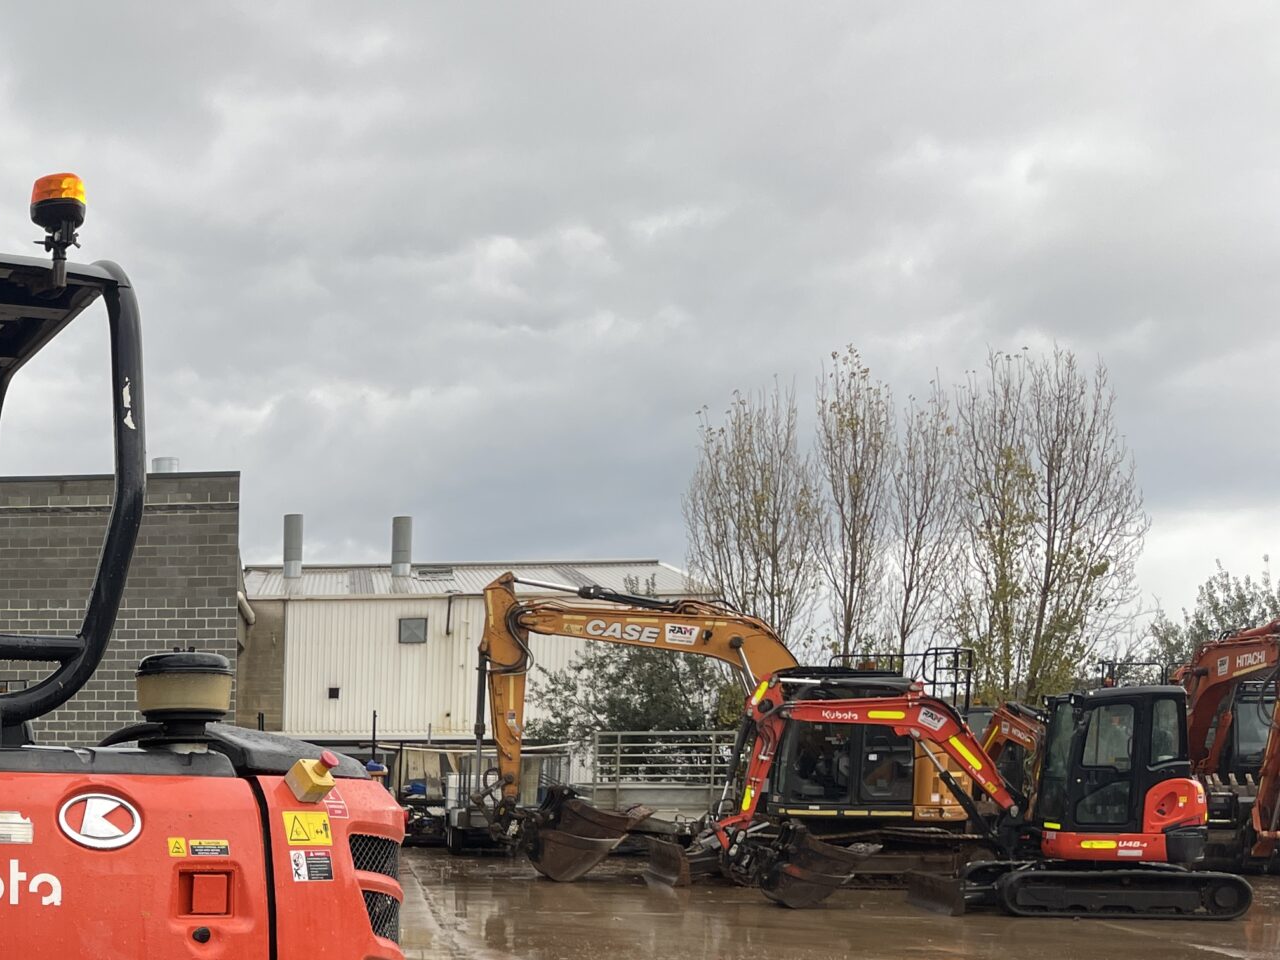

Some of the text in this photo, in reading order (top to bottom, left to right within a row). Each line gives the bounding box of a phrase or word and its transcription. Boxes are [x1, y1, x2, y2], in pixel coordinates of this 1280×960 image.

[586, 619, 660, 643] CASE
[669, 625, 695, 636] RAM
[1236, 650, 1266, 668] HITACHI
[822, 709, 858, 720] Kubota
